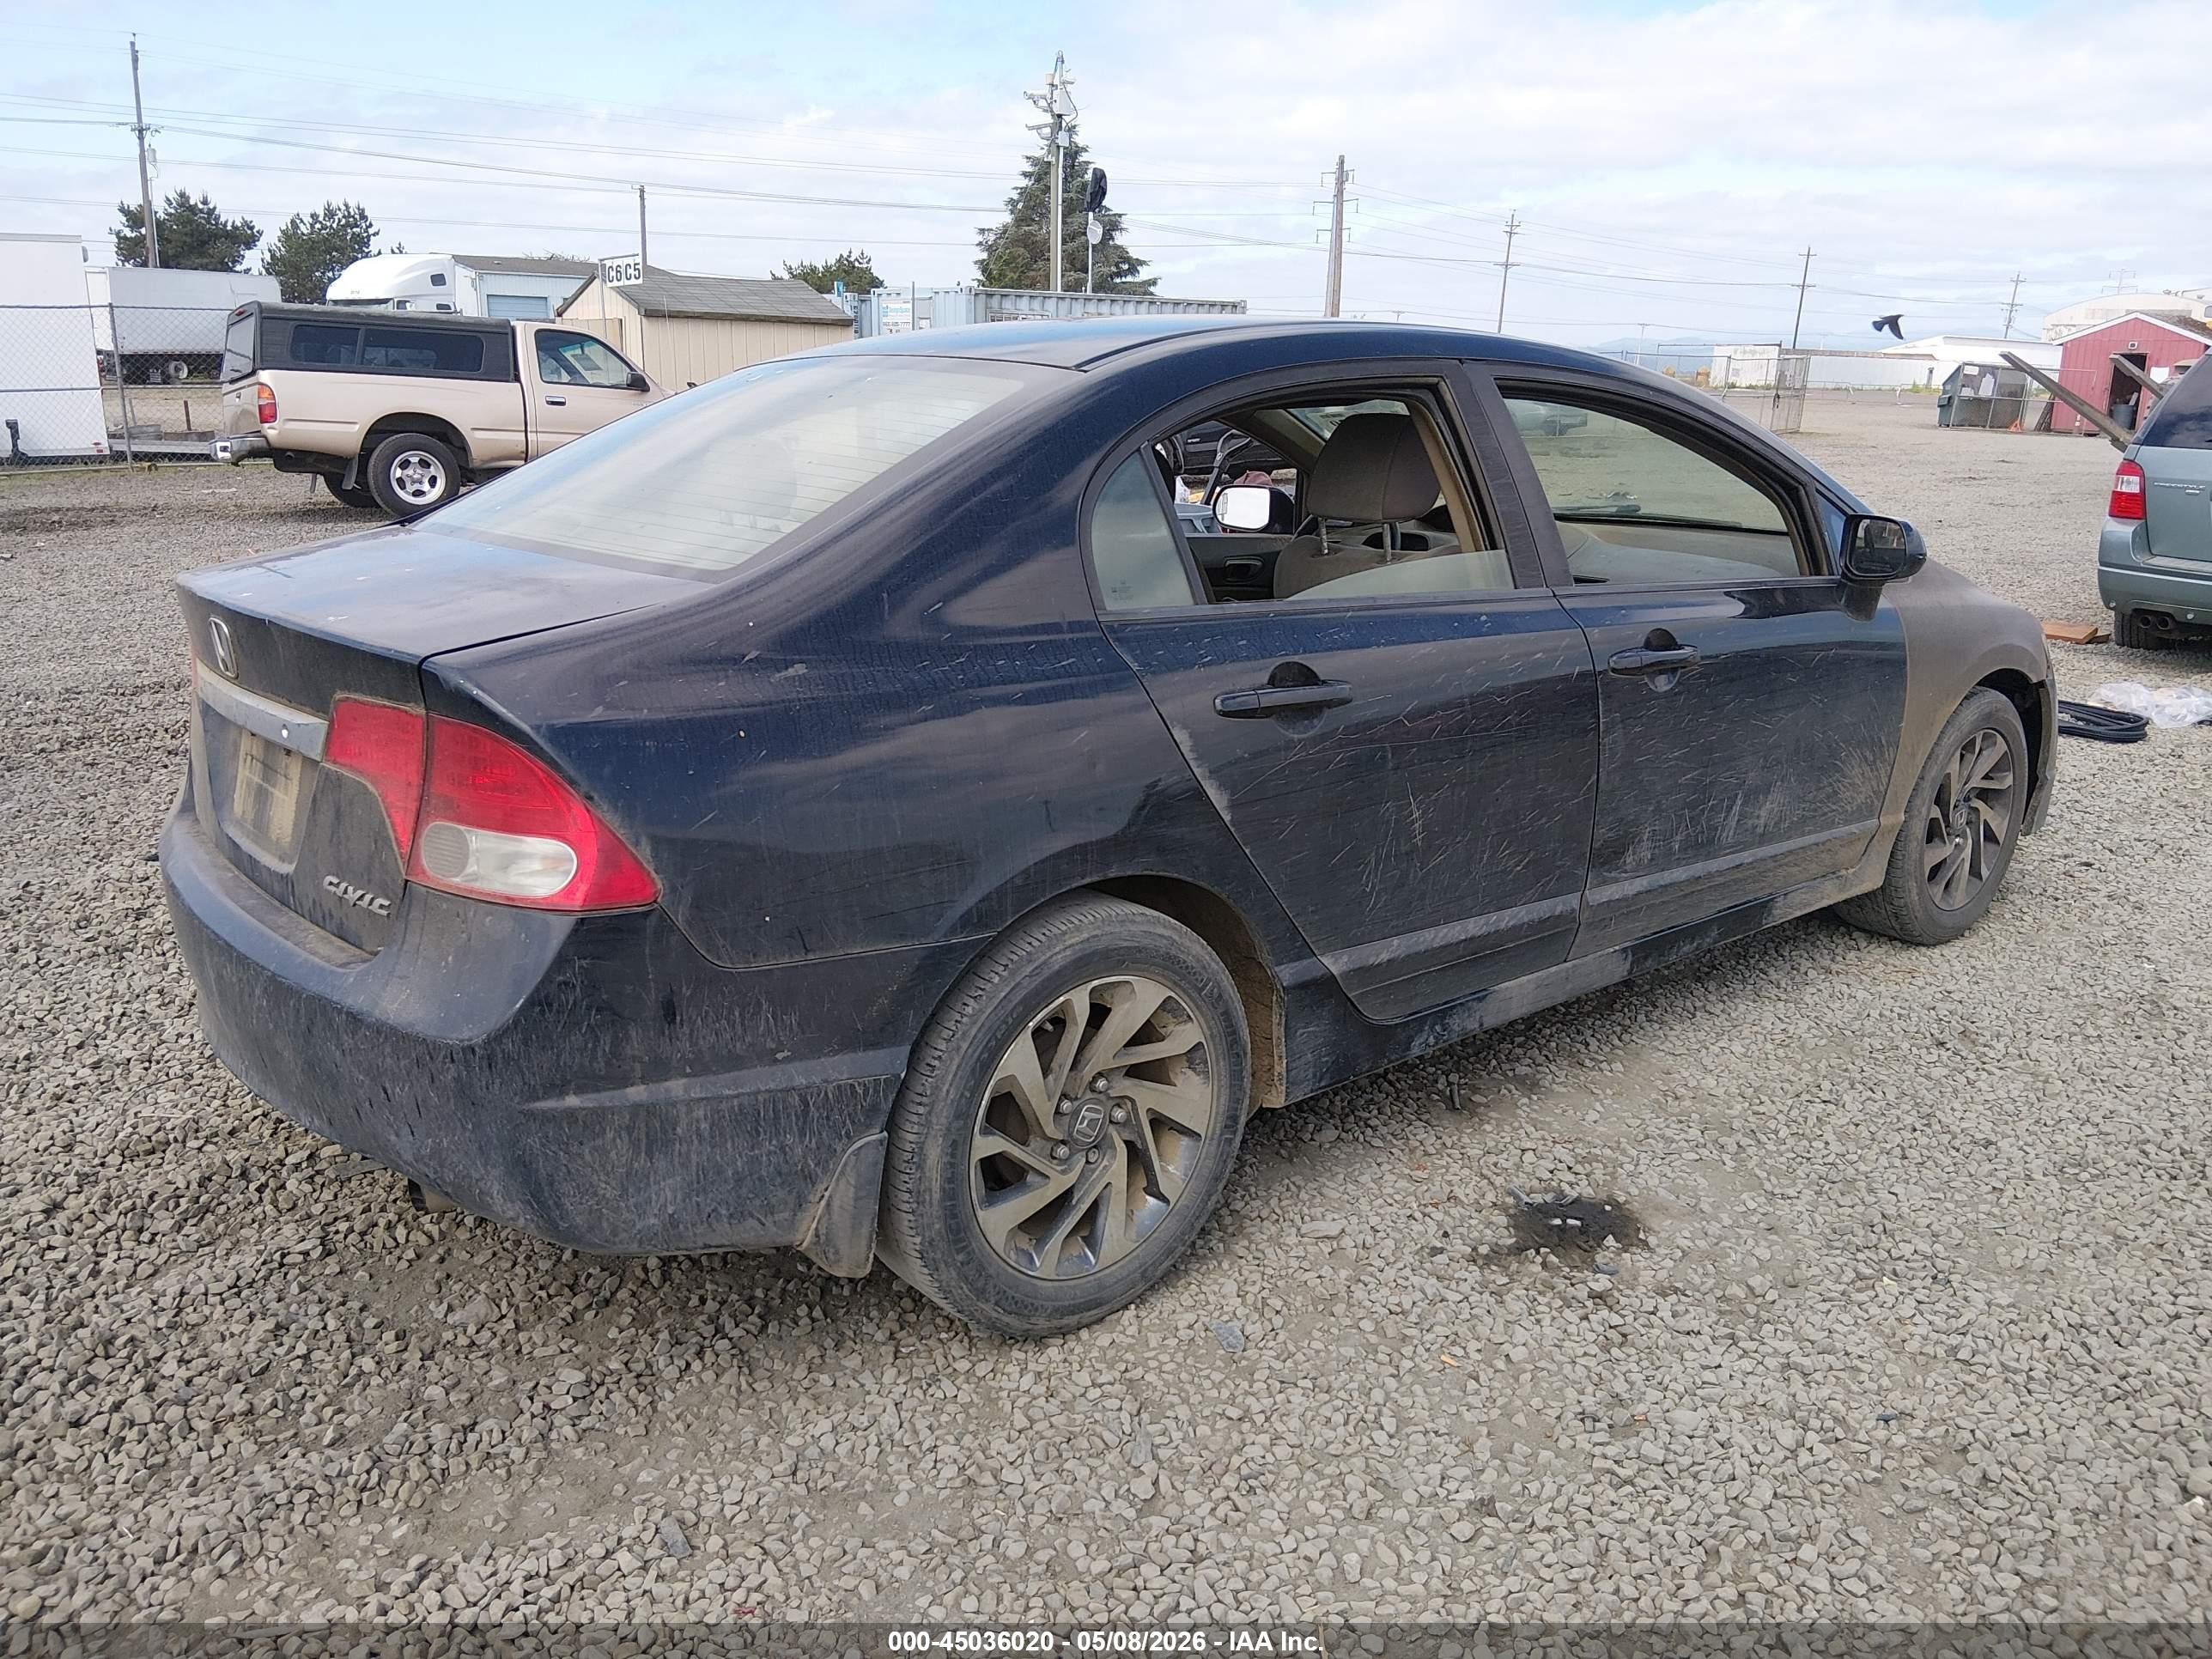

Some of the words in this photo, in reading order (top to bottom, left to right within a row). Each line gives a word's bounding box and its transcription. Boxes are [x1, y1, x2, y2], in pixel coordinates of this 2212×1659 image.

[607, 264, 623, 283] C6
[624, 262, 641, 280] C5
[322, 875, 392, 917] CIVIC
